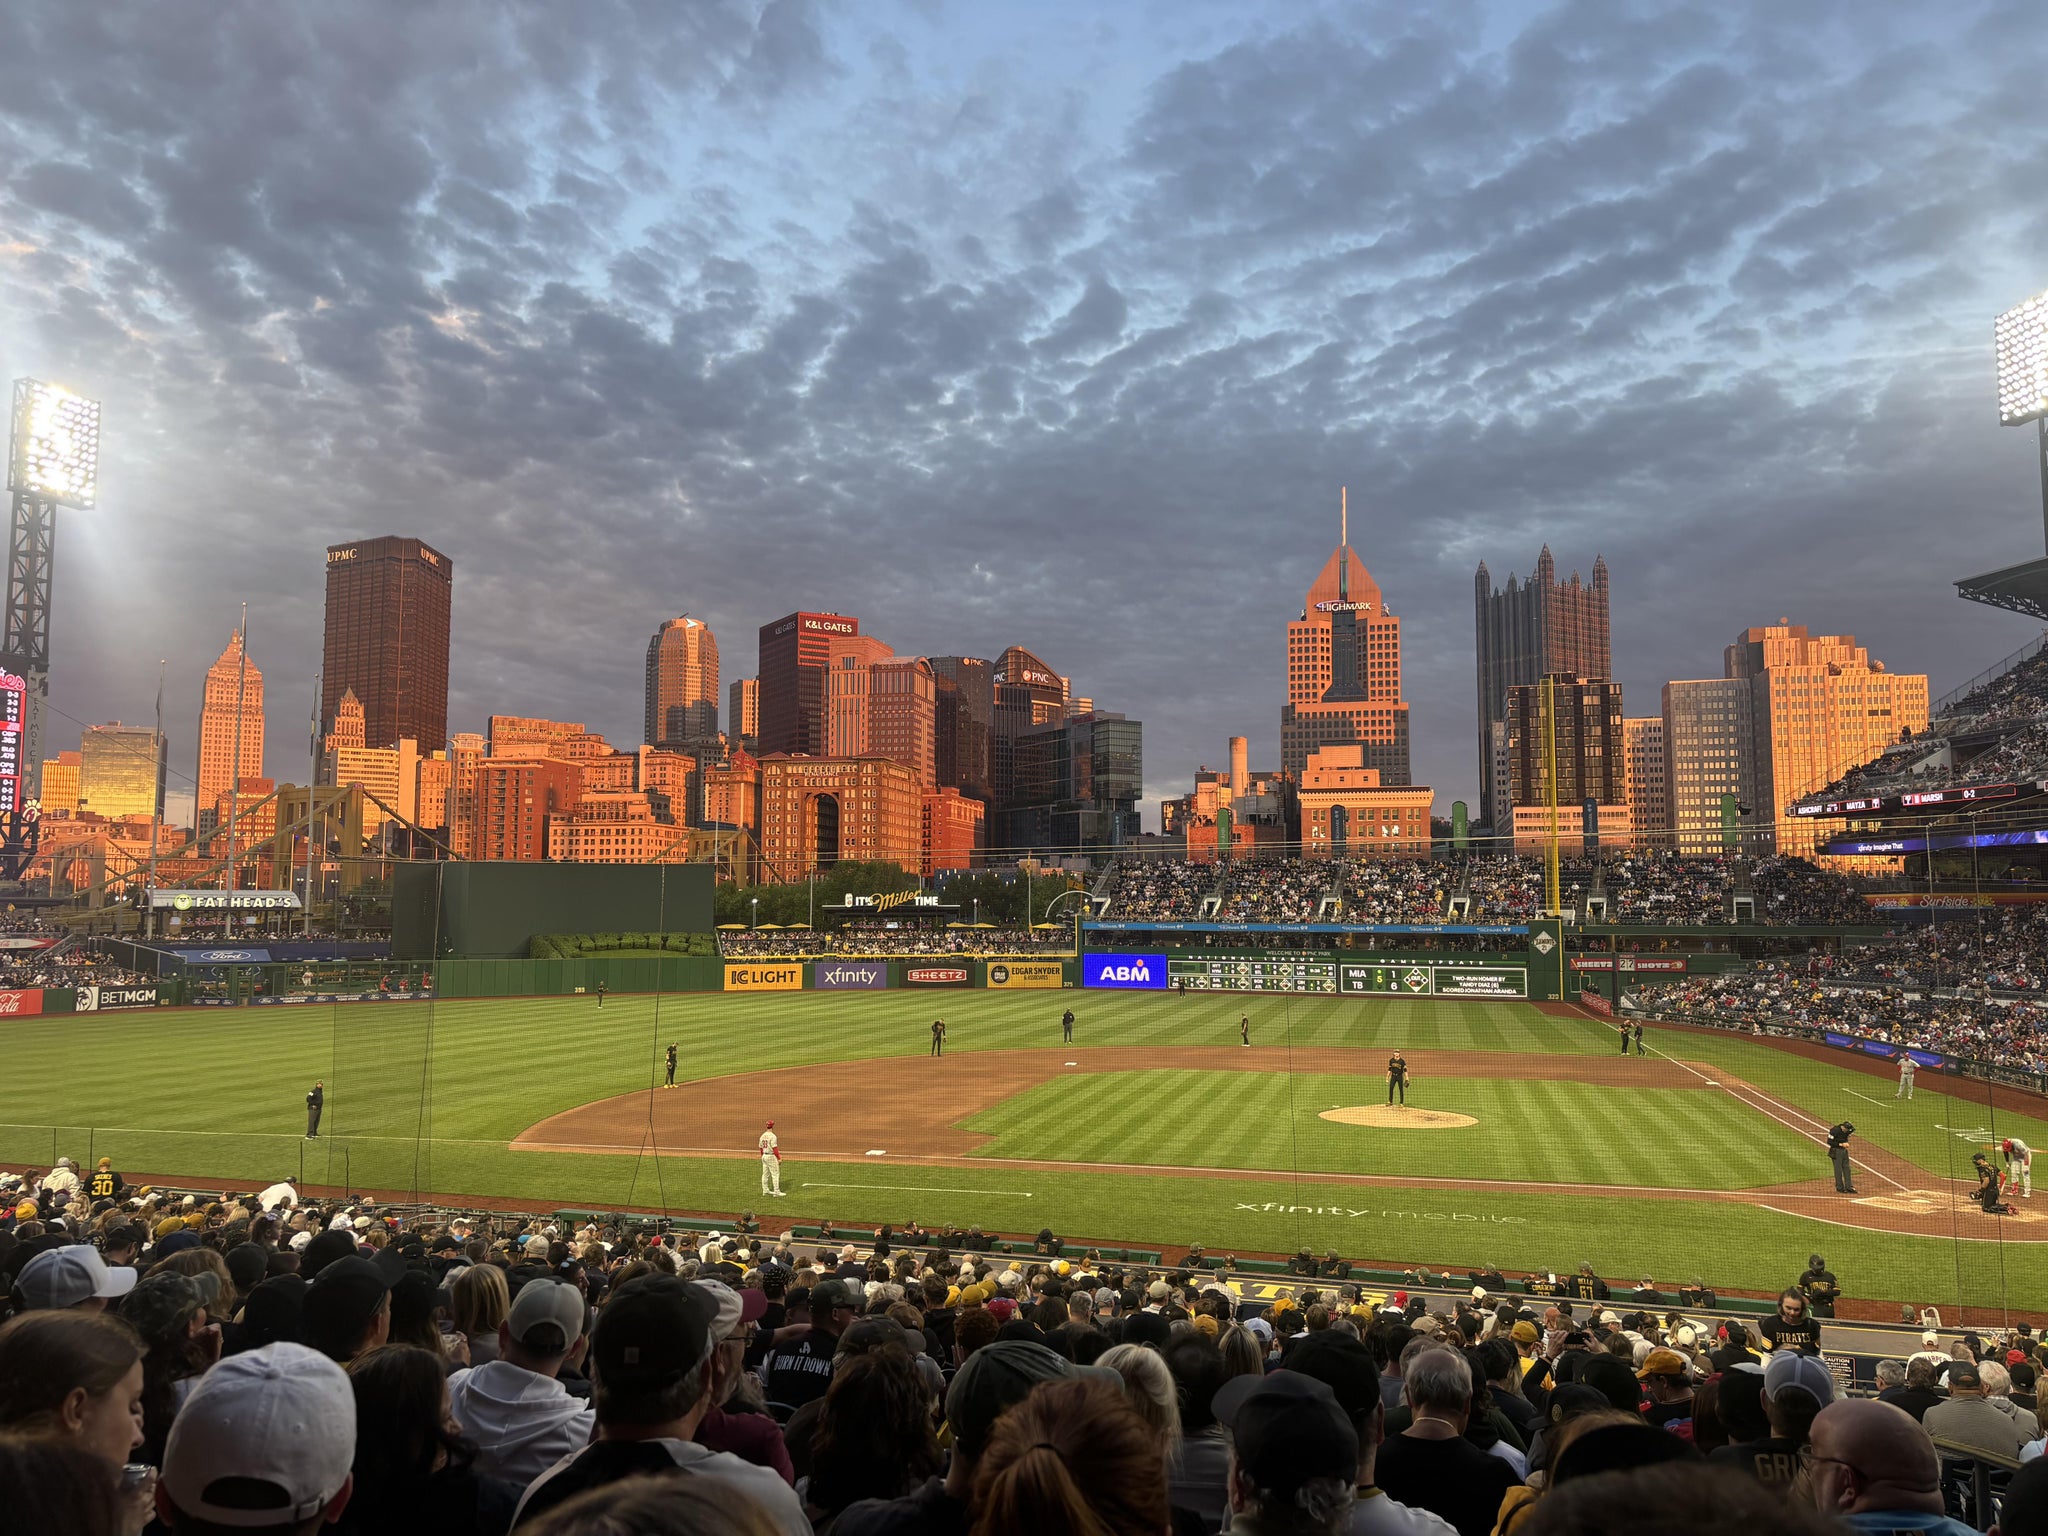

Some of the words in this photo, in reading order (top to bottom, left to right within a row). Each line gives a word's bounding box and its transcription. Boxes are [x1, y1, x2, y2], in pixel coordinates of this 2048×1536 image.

[327, 548, 357, 562] UPMC
[420, 548, 439, 566] UPMC
[1321, 602, 1371, 612] HIGHMARK
[805, 620, 822, 630] K&L
[823, 622, 852, 633] GATES
[970, 659, 984, 667] PNC
[993, 672, 1005, 683] PNC
[1032, 672, 1049, 683] PNC
[30, 723, 39, 747] MOR
[1963, 790, 1975, 798] 0-2
[196, 897, 223, 908] FAT
[230, 897, 292, 908] HEAD'S
[870, 889, 922, 913] Miller
[914, 896, 939, 906] TIME
[1919, 894, 1969, 908] Surfside
[209, 951, 242, 961] Ford
[752, 970, 796, 983] LIGHT
[825, 967, 877, 985] xfinity
[911, 971, 963, 979] SHEETZ
[1011, 967, 1033, 975] EDGAR
[1034, 967, 1060, 975] SNYDER
[1100, 966, 1150, 982] ABM
[1349, 969, 1367, 978] MIA
[1391, 970, 1396, 978] 1
[1377, 975, 1383, 983] 5
[1352, 981, 1363, 990] TB
[1391, 982, 1398, 990] 6
[101, 989, 156, 1004] BETMGM
[91, 1180, 114, 1196] 30
[1234, 1202, 1369, 1218] xfinity
[1383, 1210, 1527, 1224] mobile
[1775, 1332, 1811, 1343] PIRATES
[793, 1356, 805, 1371] IT
[803, 1357, 832, 1377] DOWN
